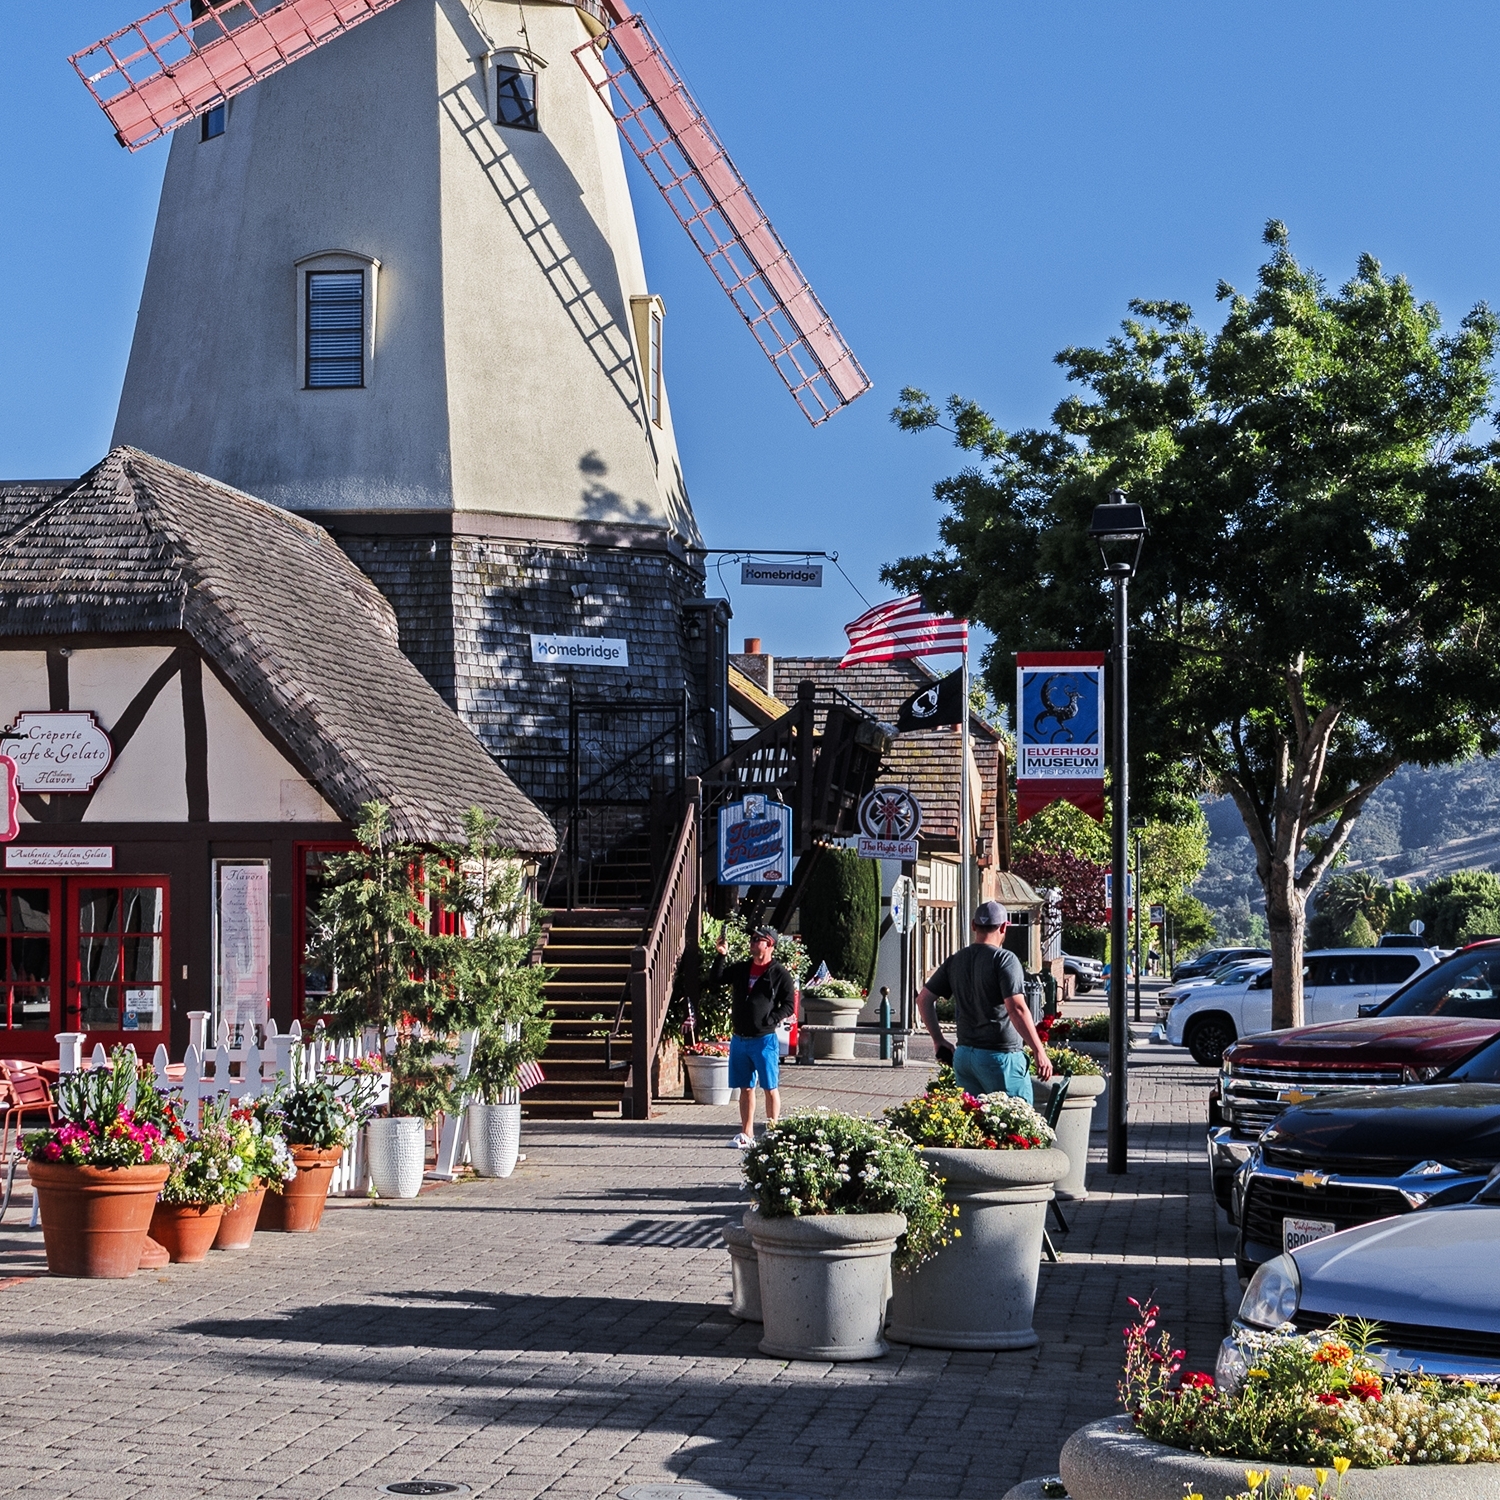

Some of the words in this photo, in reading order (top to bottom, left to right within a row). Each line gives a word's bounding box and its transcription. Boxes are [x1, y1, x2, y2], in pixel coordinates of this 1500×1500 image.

[746, 568, 816, 582] Homebridge
[538, 642, 620, 660] Homebridge
[6, 742, 42, 765] Cafe
[43, 747, 55, 759] &
[55, 741, 106, 764] Gelato
[1027, 747, 1099, 756] ELVERHØJ
[1027, 758, 1099, 767] MUSEUM
[34, 771, 76, 784] Flavors
[1027, 768, 1039, 776] OF
[1040, 768, 1074, 776] HISTORY
[729, 820, 780, 844] Tower
[11, 848, 50, 858] Authentic
[53, 848, 81, 858] Italian
[82, 848, 107, 860] Gelato
[727, 841, 781, 865] Pizza
[862, 840, 876, 851] The
[898, 842, 913, 855] Gift
[226, 868, 263, 880] Flavors
